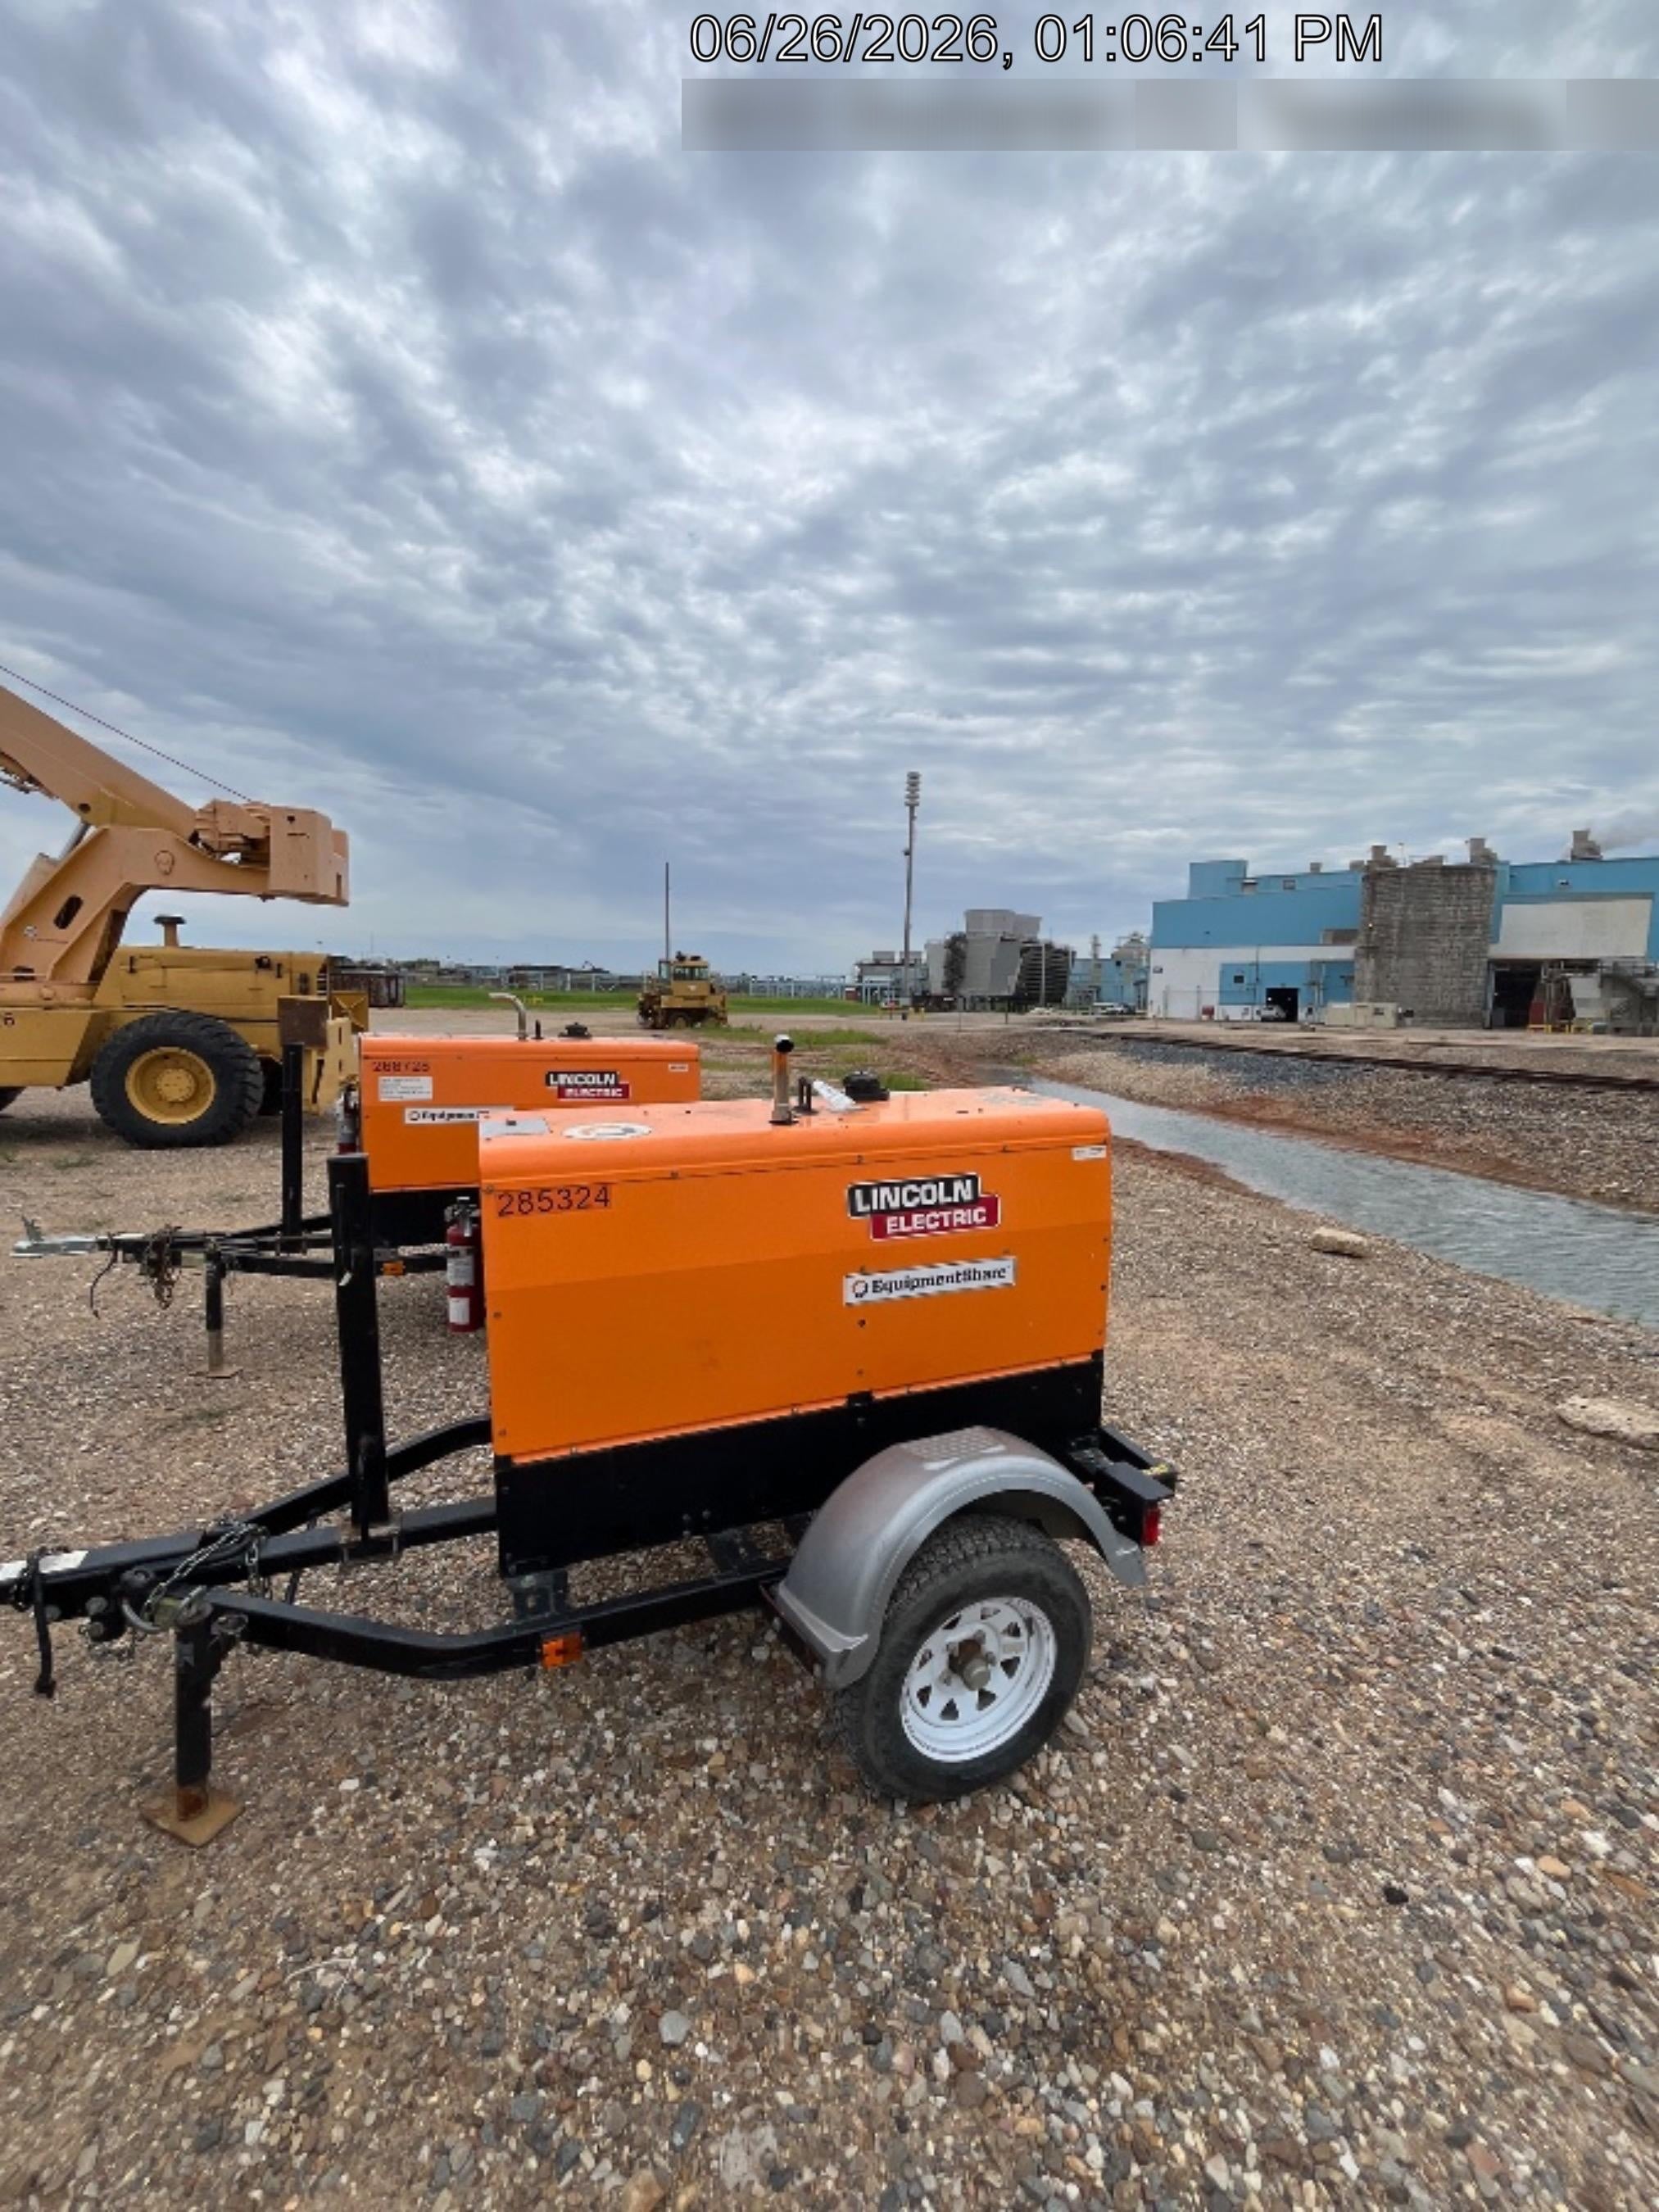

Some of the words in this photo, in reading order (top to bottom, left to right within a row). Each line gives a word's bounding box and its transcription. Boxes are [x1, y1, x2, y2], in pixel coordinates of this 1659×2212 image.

[550, 1073, 614, 1086] LINCOLN
[498, 1185, 610, 1217] 285324
[854, 1180, 974, 1213] LINCOLN
[886, 1207, 987, 1235] ELECTRIC
[871, 1267, 1006, 1294] EquipmentShare
